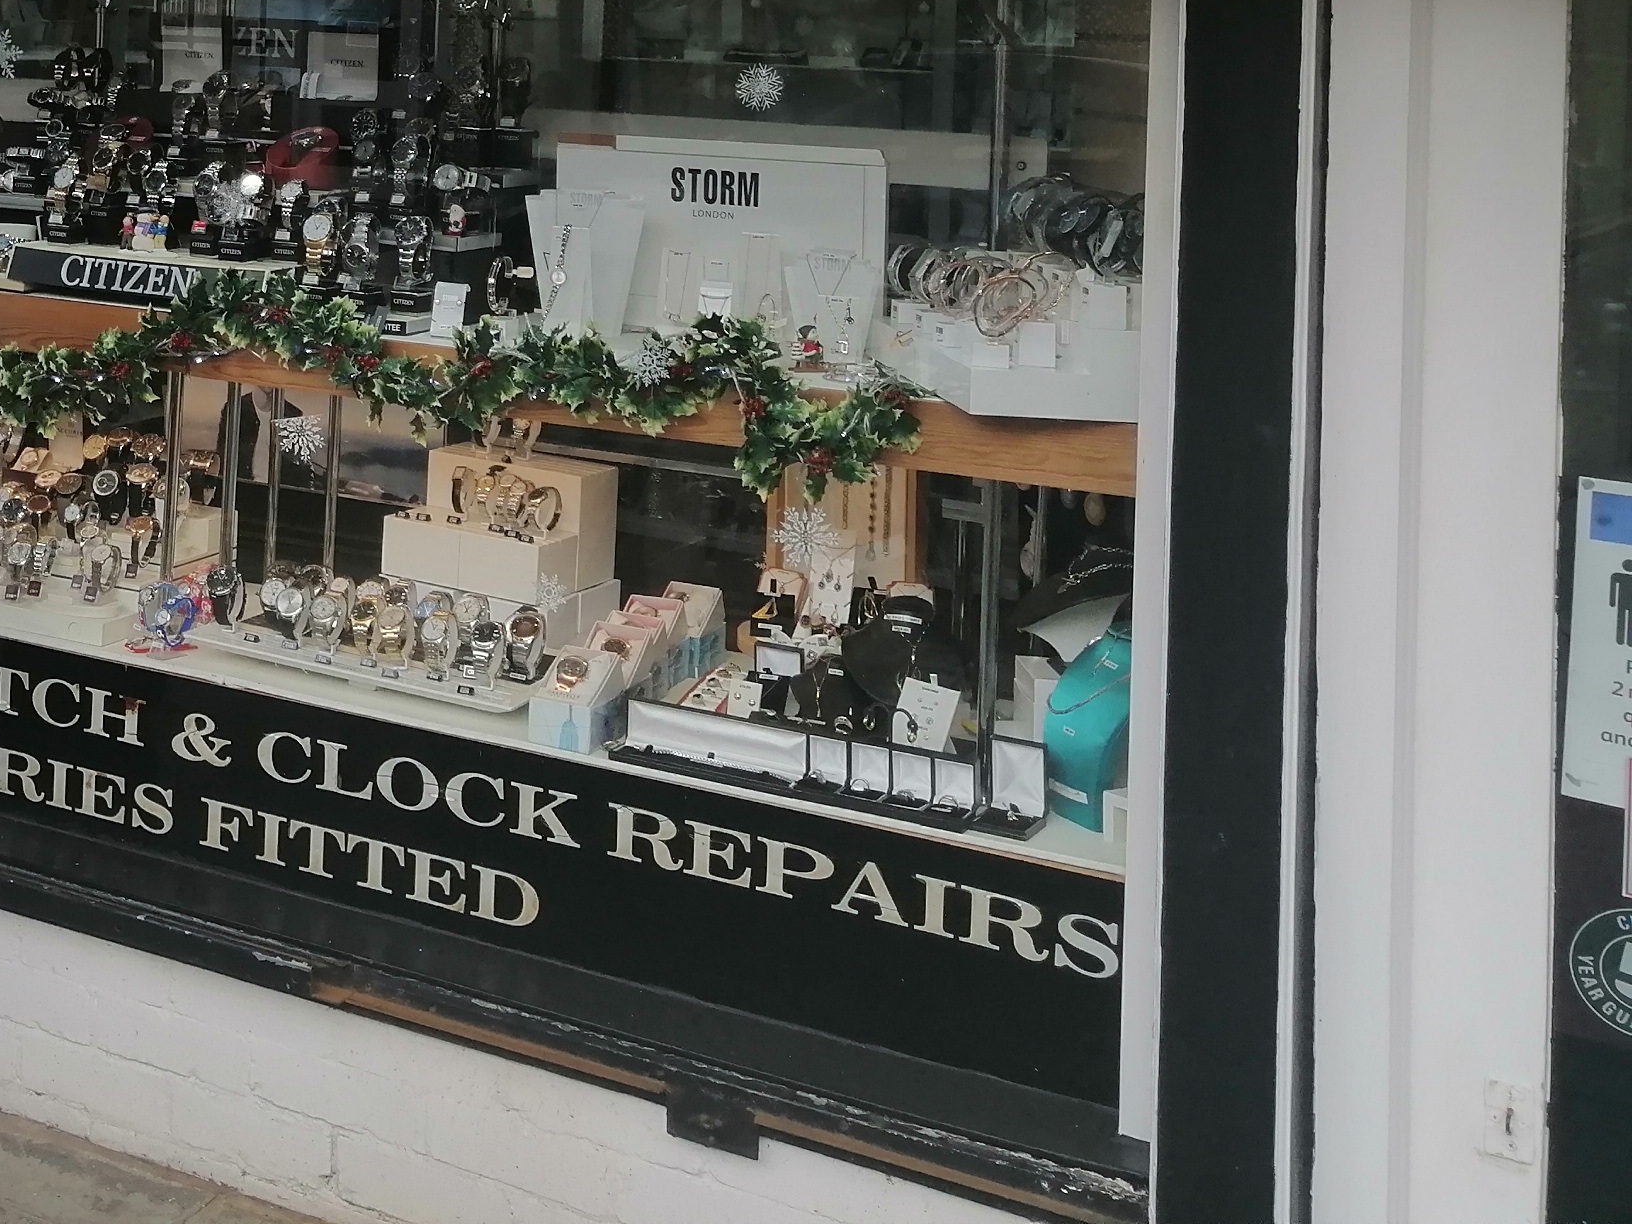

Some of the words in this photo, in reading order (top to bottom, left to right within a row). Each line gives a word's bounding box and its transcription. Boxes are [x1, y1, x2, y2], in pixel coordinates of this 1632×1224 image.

[671, 166, 760, 208] STORM
[692, 209, 735, 220] LONDON
[60, 254, 195, 299] CITIZEN
[1612, 681, 1624, 697] 2
[171, 713, 232, 768] &
[256, 730, 581, 849] CLOCK
[606, 801, 1120, 979] REPAIRS
[199, 796, 540, 927] FITTED
[1577, 955, 1605, 1001] YEAR
